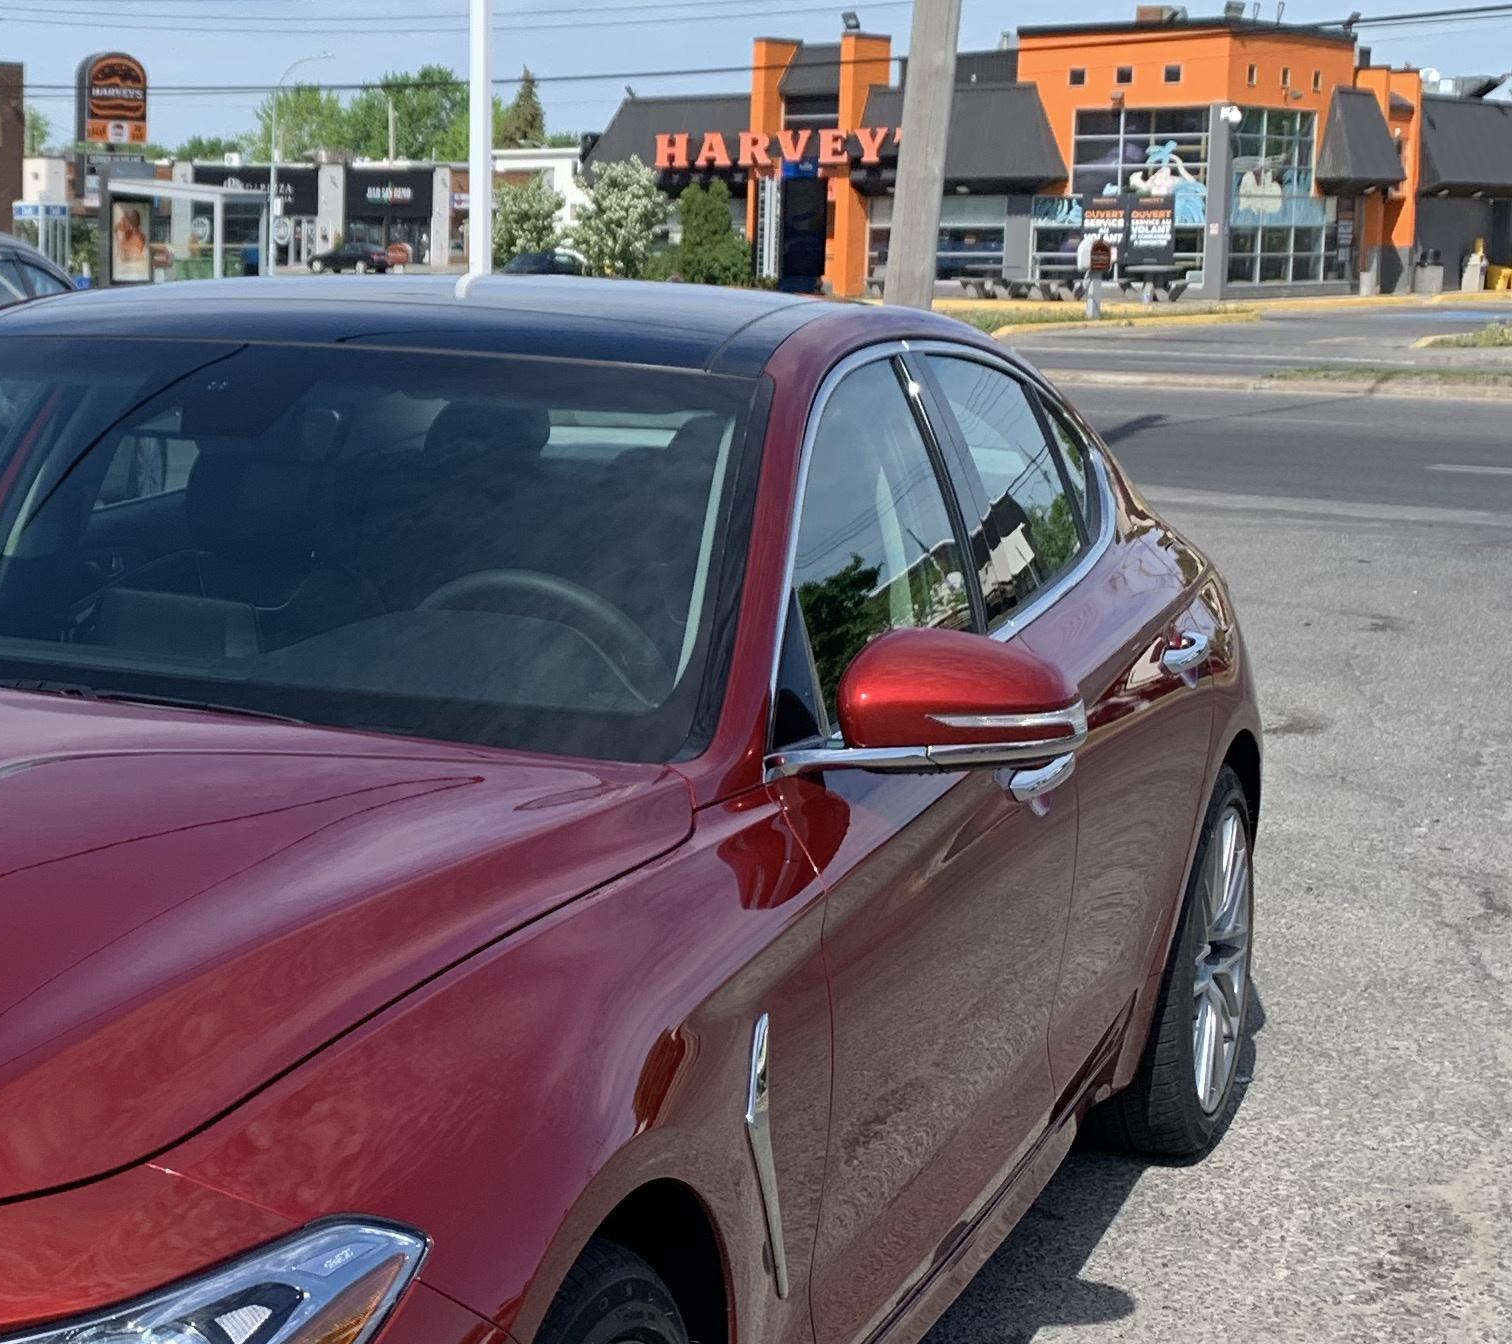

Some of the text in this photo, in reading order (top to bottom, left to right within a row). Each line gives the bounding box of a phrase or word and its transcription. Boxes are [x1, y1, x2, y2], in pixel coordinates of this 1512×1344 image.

[654, 127, 902, 169] HARVEY'
[1084, 210, 1125, 219] OUVERT
[1131, 210, 1172, 219] OUVERT
[1084, 218, 1125, 228] SERVICE
[1131, 225, 1171, 234] VOLANT
